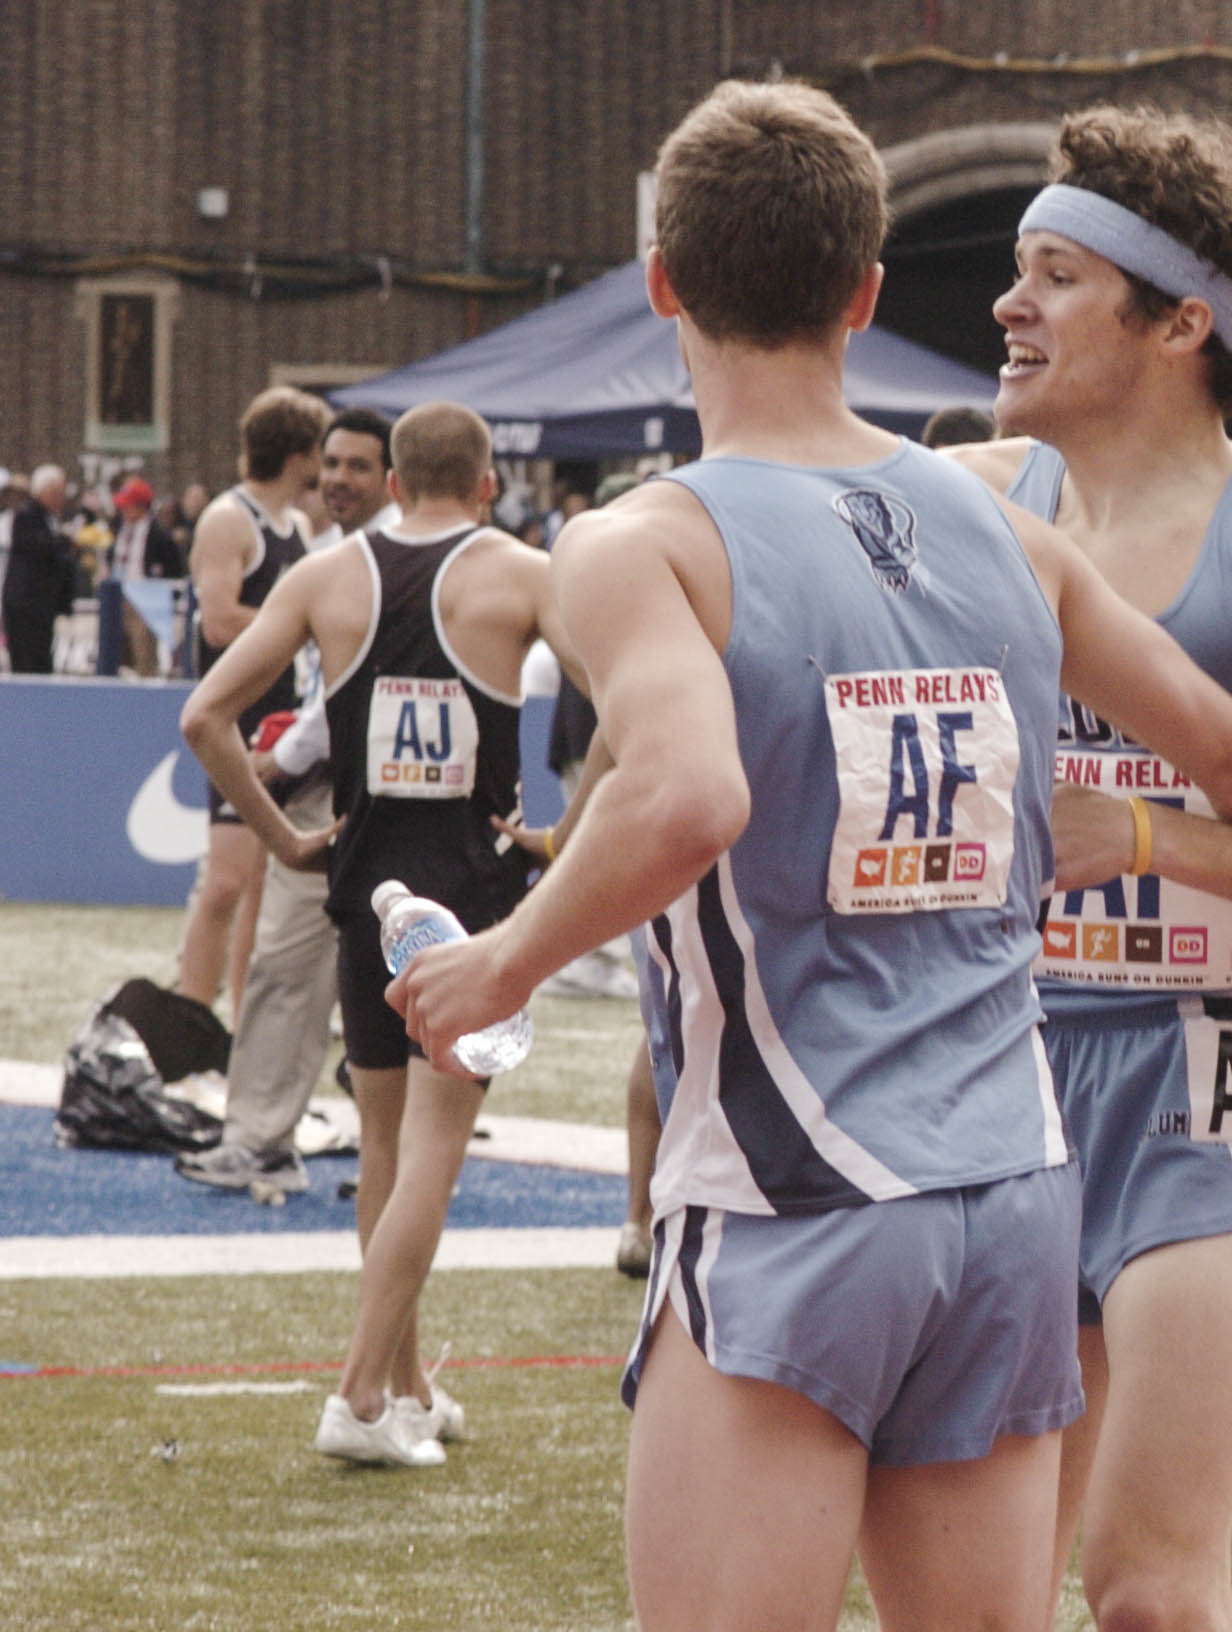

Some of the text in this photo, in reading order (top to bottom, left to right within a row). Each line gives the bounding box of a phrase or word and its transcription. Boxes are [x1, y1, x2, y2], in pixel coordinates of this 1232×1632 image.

[380, 681, 413, 696] PENN
[836, 674, 1000, 708] PENN RELAYS
[392, 700, 452, 762] AJ
[878, 712, 977, 841] AF
[1115, 759, 1191, 788] RELA
